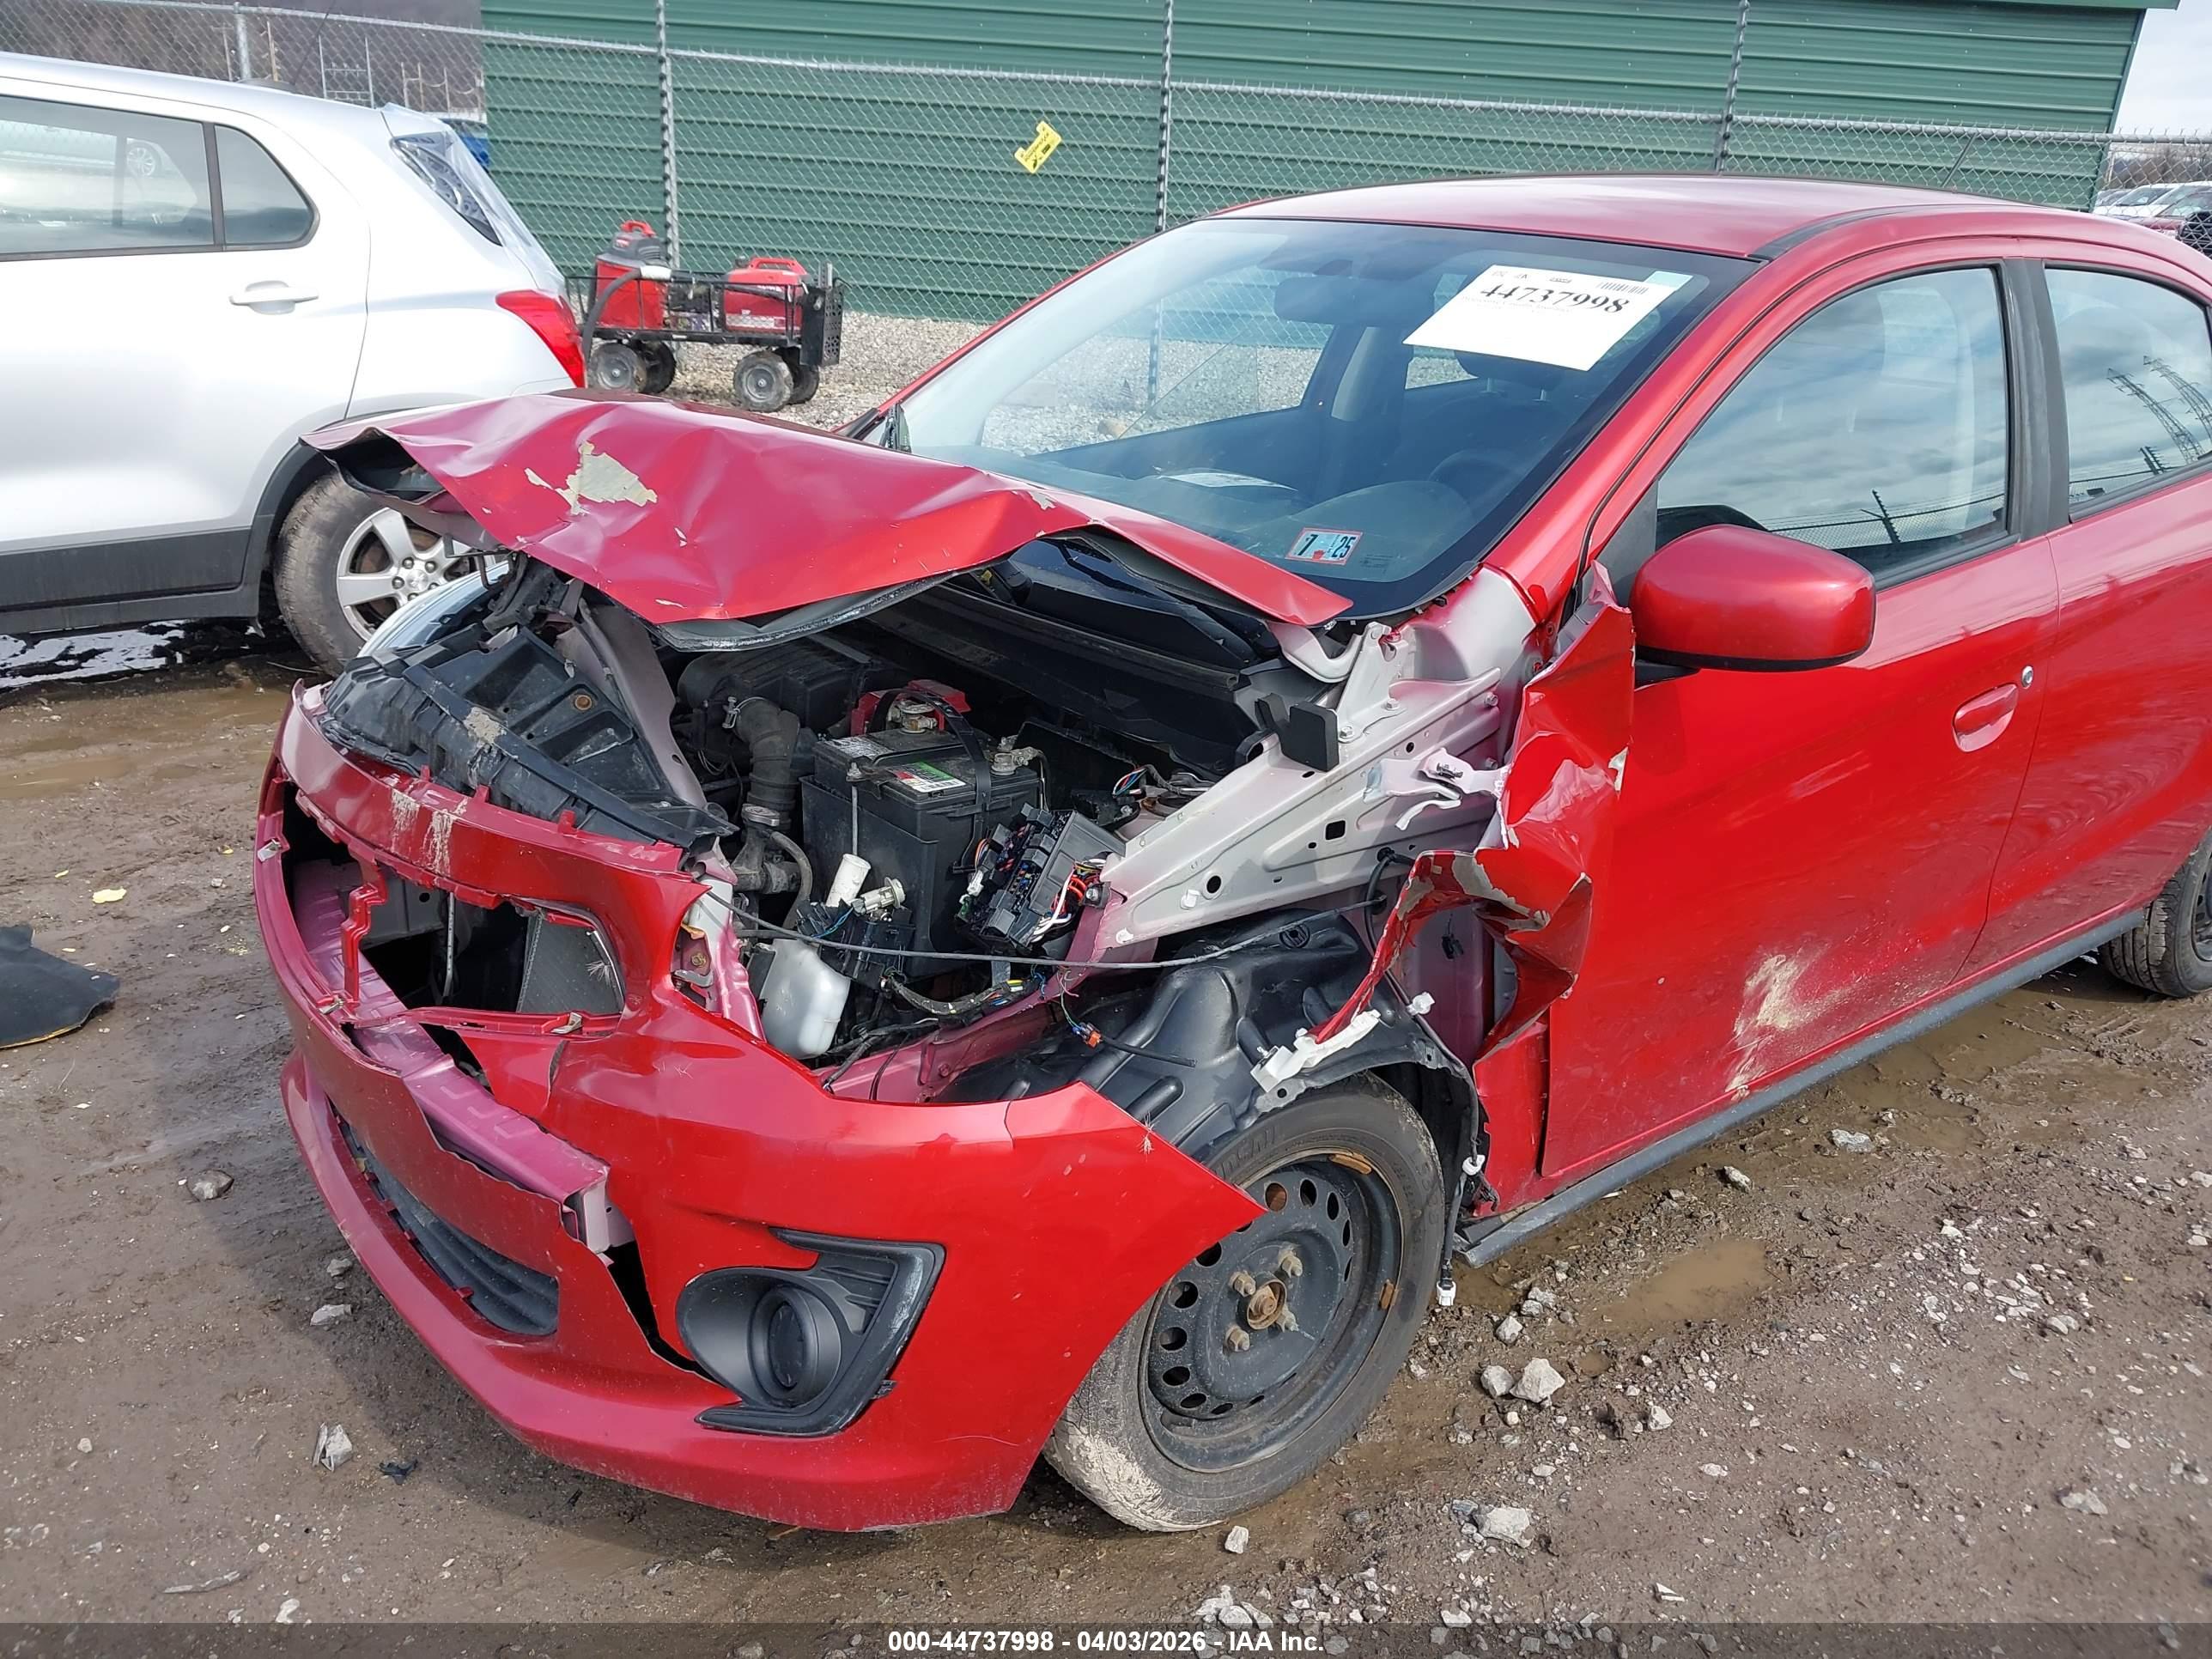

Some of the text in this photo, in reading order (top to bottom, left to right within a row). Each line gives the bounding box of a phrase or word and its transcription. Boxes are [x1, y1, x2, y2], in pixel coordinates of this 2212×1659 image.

[1480, 283, 1630, 313] 44737998
[1297, 533, 1319, 556] 7
[1331, 535, 1356, 558] 25
